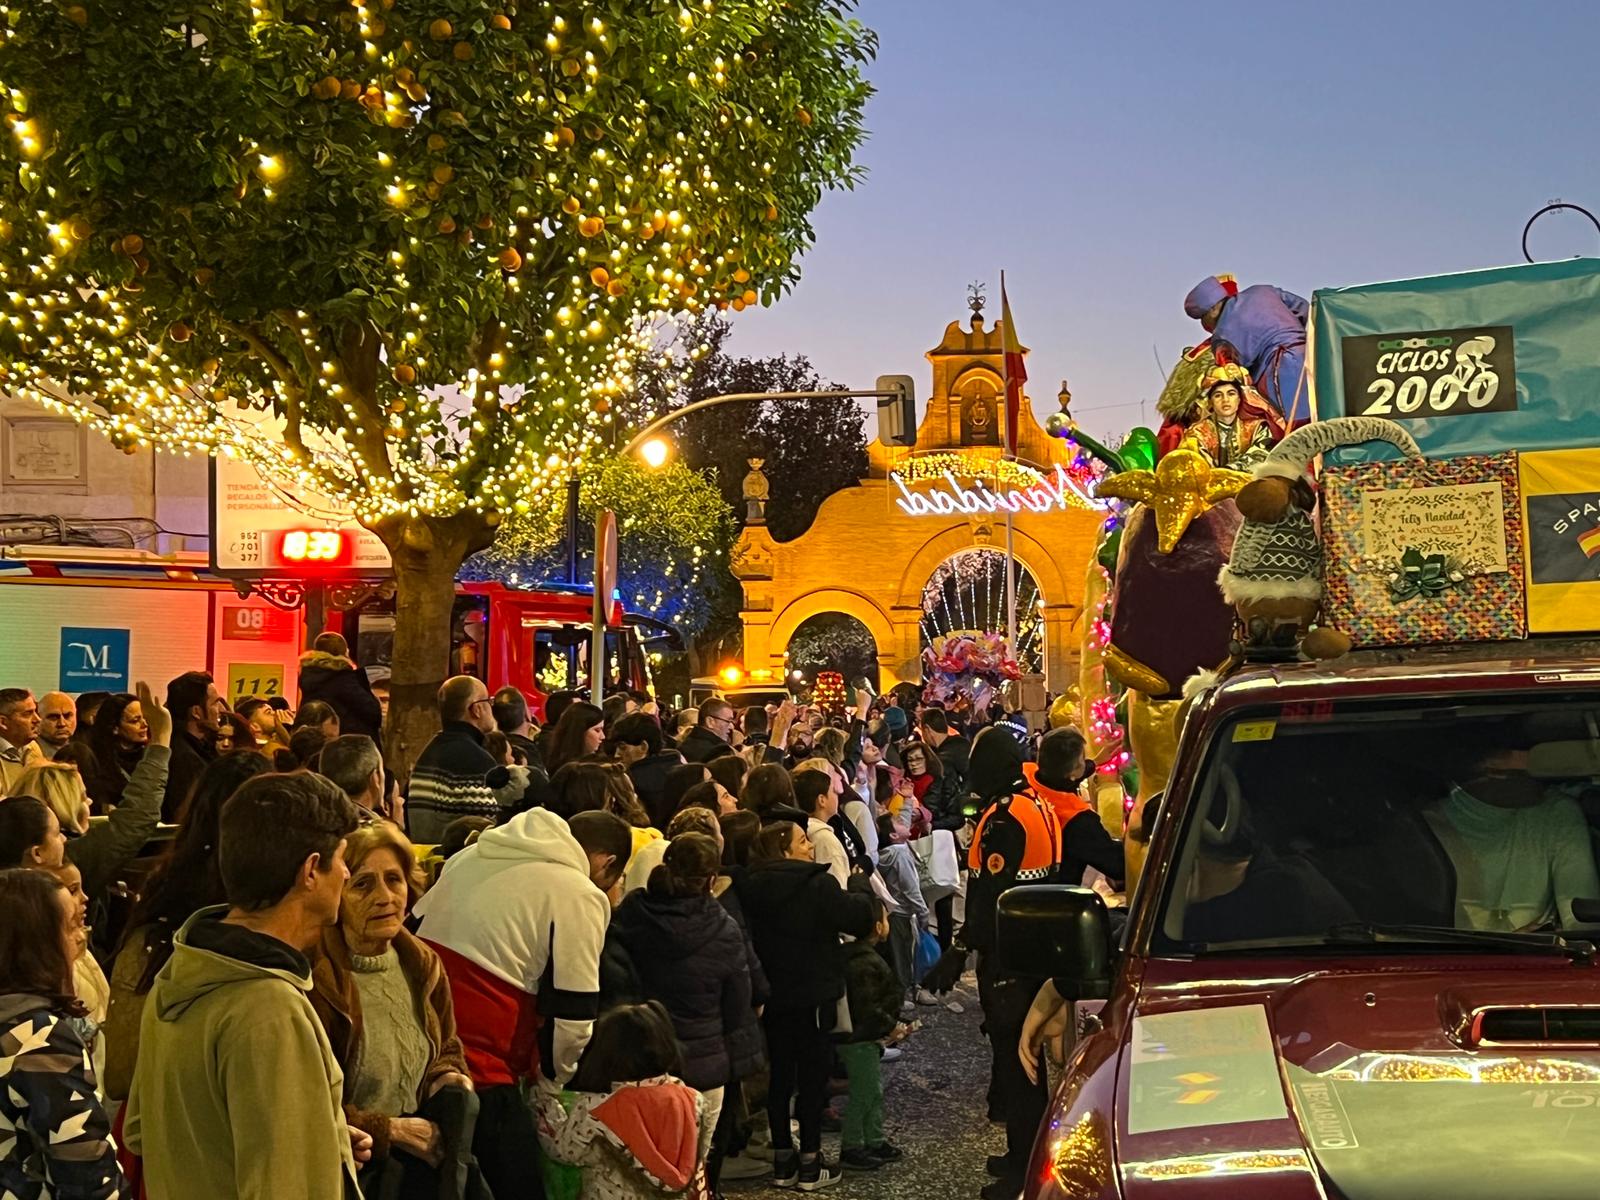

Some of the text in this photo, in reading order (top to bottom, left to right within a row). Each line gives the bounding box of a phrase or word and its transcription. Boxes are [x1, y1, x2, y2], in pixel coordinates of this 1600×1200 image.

[1376, 348, 1452, 374] CICLOS
[1361, 373, 1499, 416] 2000
[226, 483, 259, 492] TIENDA
[226, 493, 268, 501] REGALOS
[1400, 510, 1465, 526] Feliz Navidad
[1553, 499, 1600, 534] SPA
[235, 677, 279, 695] 112
